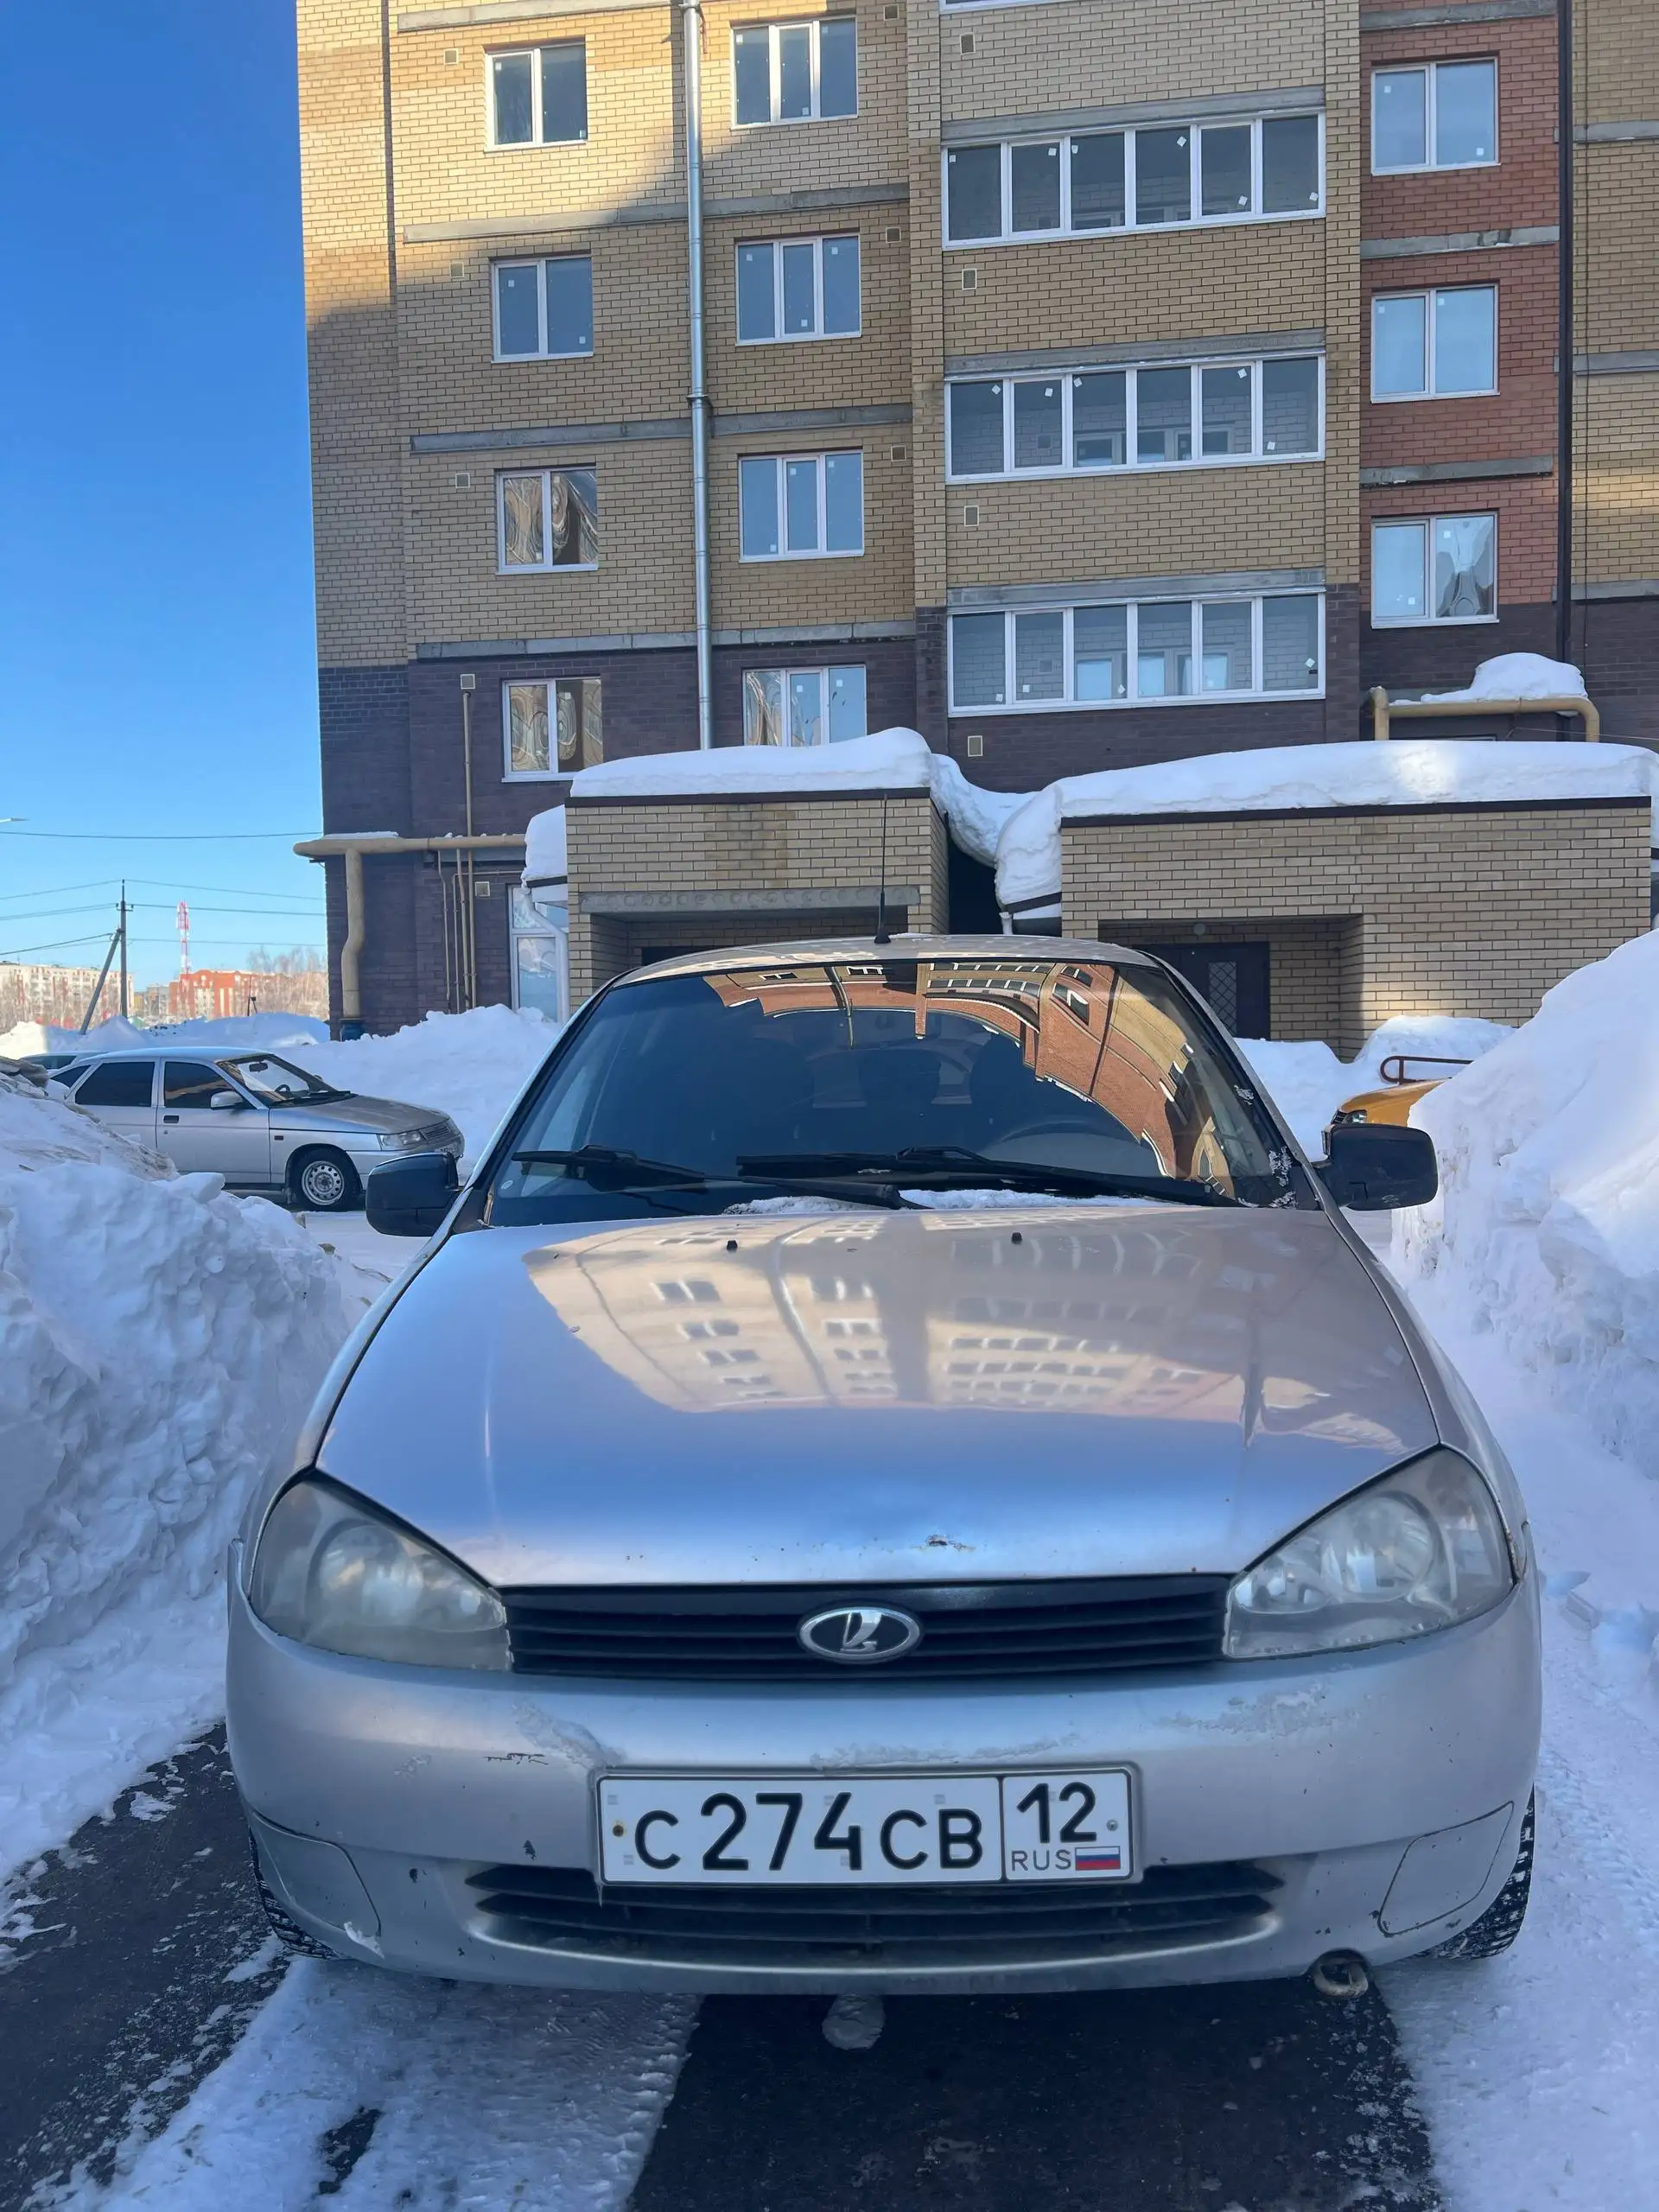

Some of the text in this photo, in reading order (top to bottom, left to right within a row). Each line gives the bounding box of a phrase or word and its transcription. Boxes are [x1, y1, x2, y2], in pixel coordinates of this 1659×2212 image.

[634, 1782, 1097, 1871] C274CB 12
[1011, 1849, 1071, 1872] RUS
